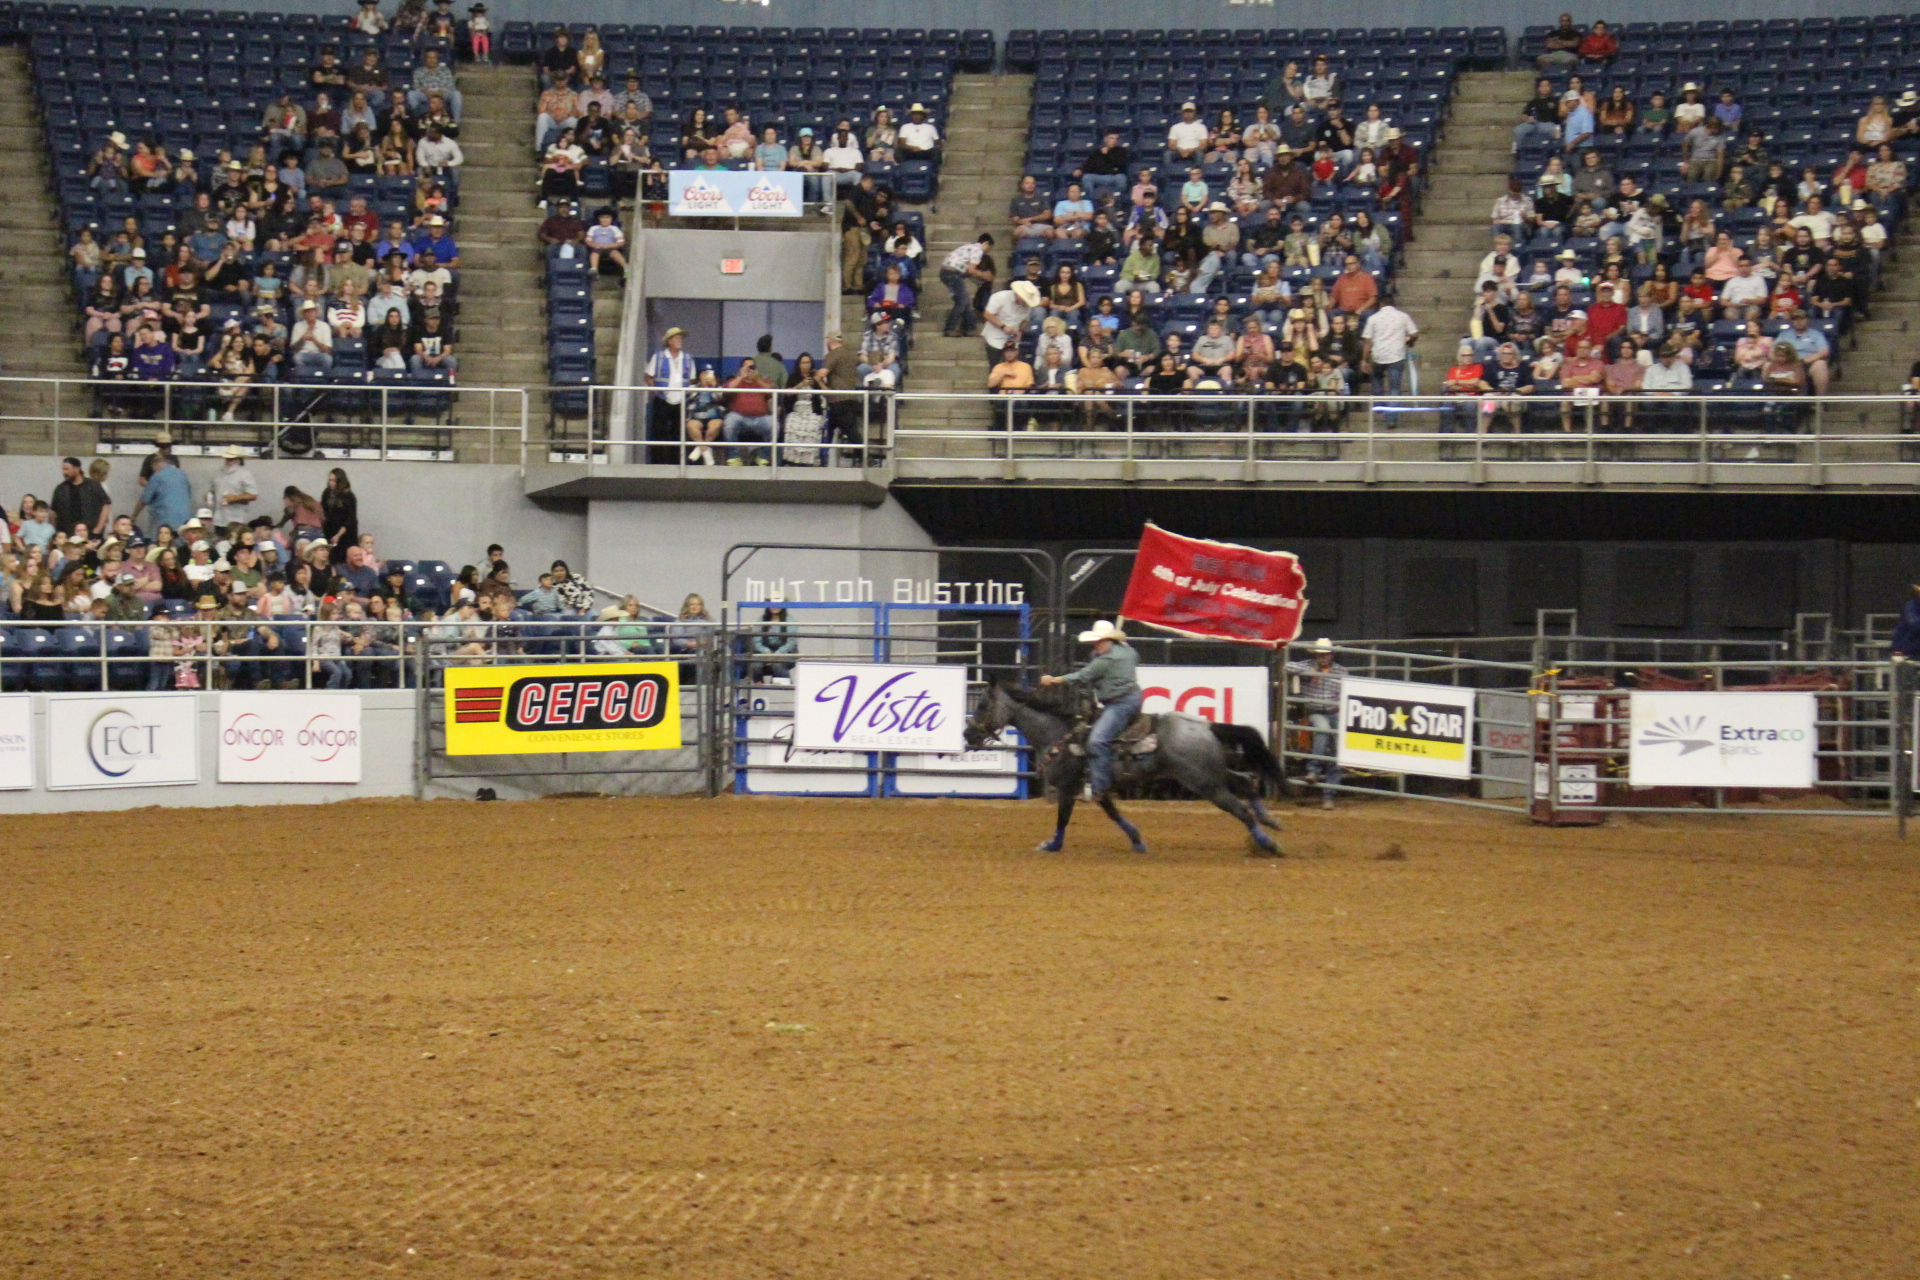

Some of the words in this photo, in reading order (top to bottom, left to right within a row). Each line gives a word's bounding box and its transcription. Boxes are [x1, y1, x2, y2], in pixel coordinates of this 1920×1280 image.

[683, 186, 724, 201] Coors
[747, 186, 788, 202] Coors
[688, 201, 718, 209] LIGHT
[752, 202, 782, 210] LIGHT
[1175, 576, 1192, 587] of
[1191, 579, 1221, 595] July
[516, 679, 659, 726] CEFCO
[814, 671, 947, 743] Vista
[104, 725, 161, 755] FCT
[223, 729, 284, 746] ONCOR
[297, 730, 358, 746] ONCOR
[528, 733, 603, 743] CONVENIENCE
[604, 731, 645, 741] STORES
[851, 734, 881, 745] REAL
[887, 735, 933, 746] ESTATE
[1720, 725, 1804, 741] Extraco
